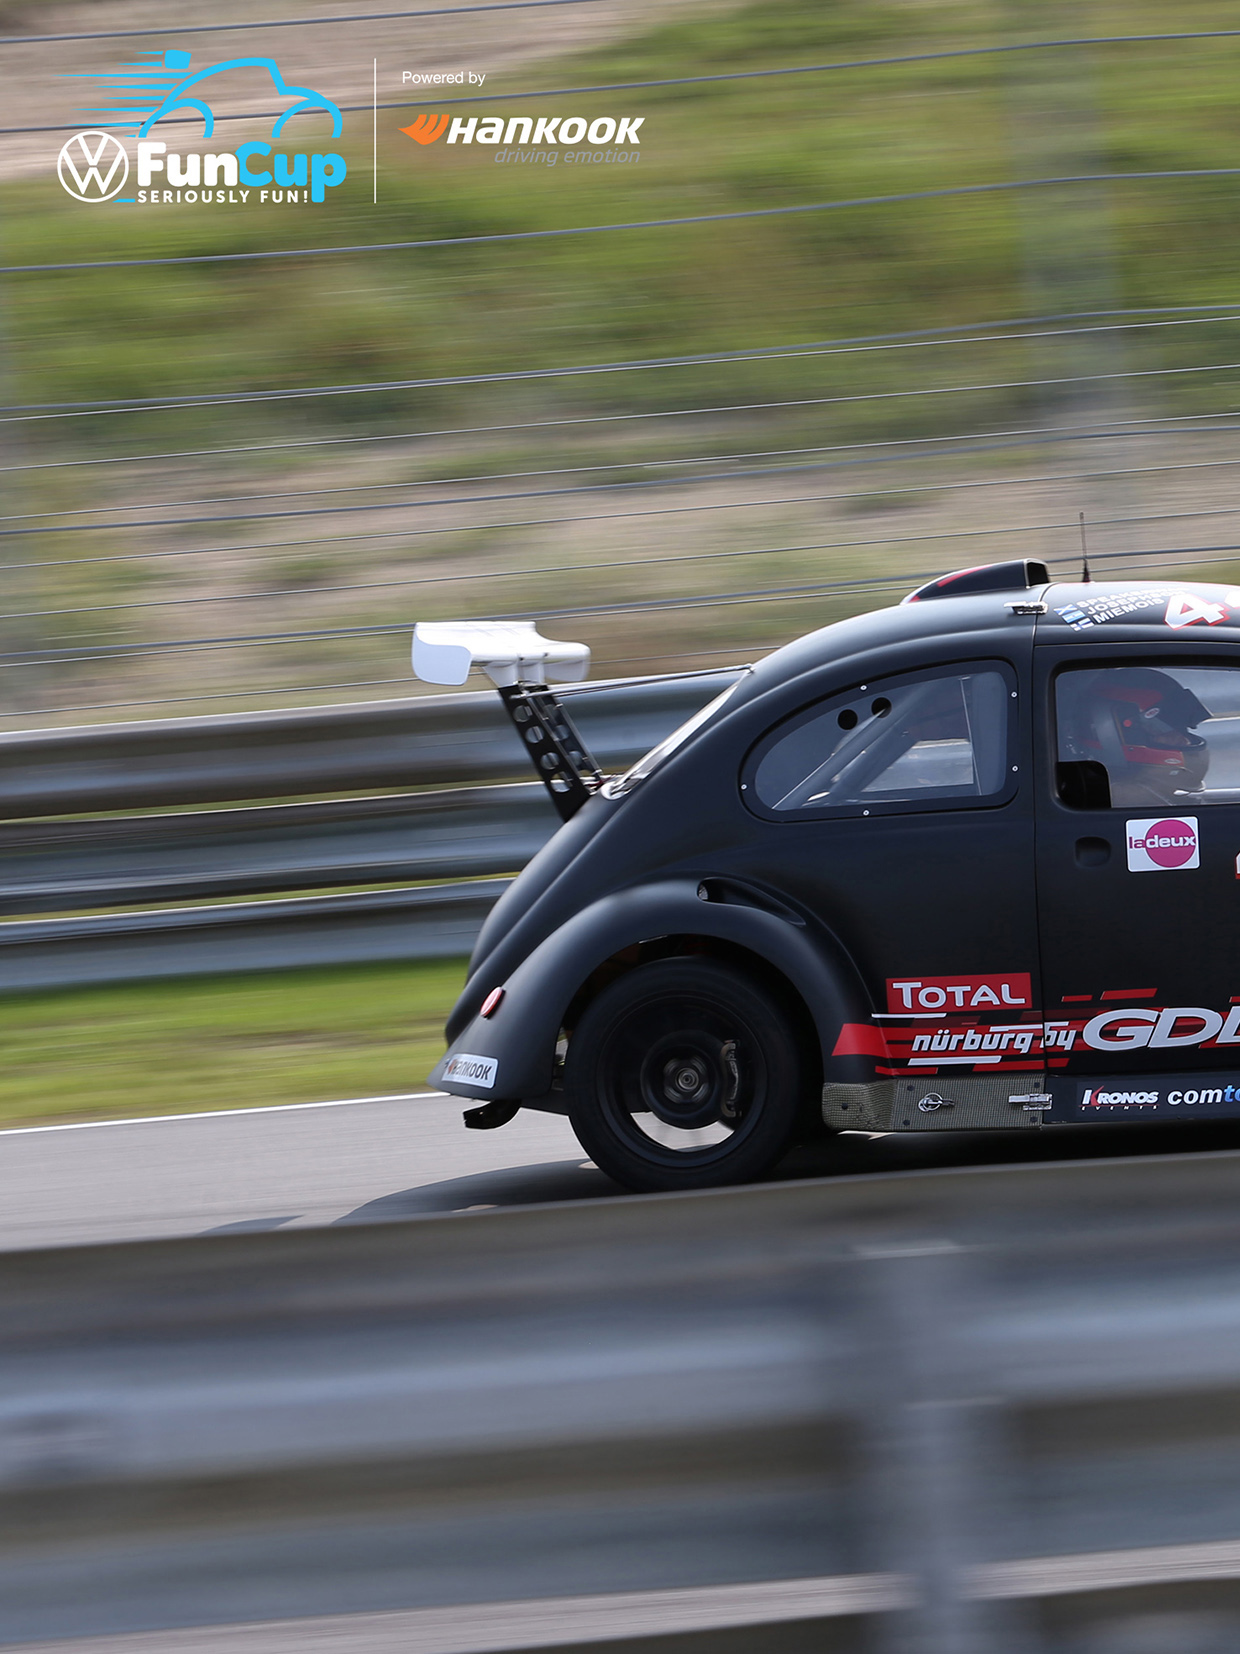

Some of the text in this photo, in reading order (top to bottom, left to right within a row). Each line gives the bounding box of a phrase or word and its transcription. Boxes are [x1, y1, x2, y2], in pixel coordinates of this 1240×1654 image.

[1092, 598, 1165, 624] MIEMOIS
[1128, 834, 1197, 849] ladeux
[892, 981, 1026, 1009] TOTAL
[911, 1029, 1034, 1054] nürburg
[1081, 1085, 1160, 1106] KRONOS
